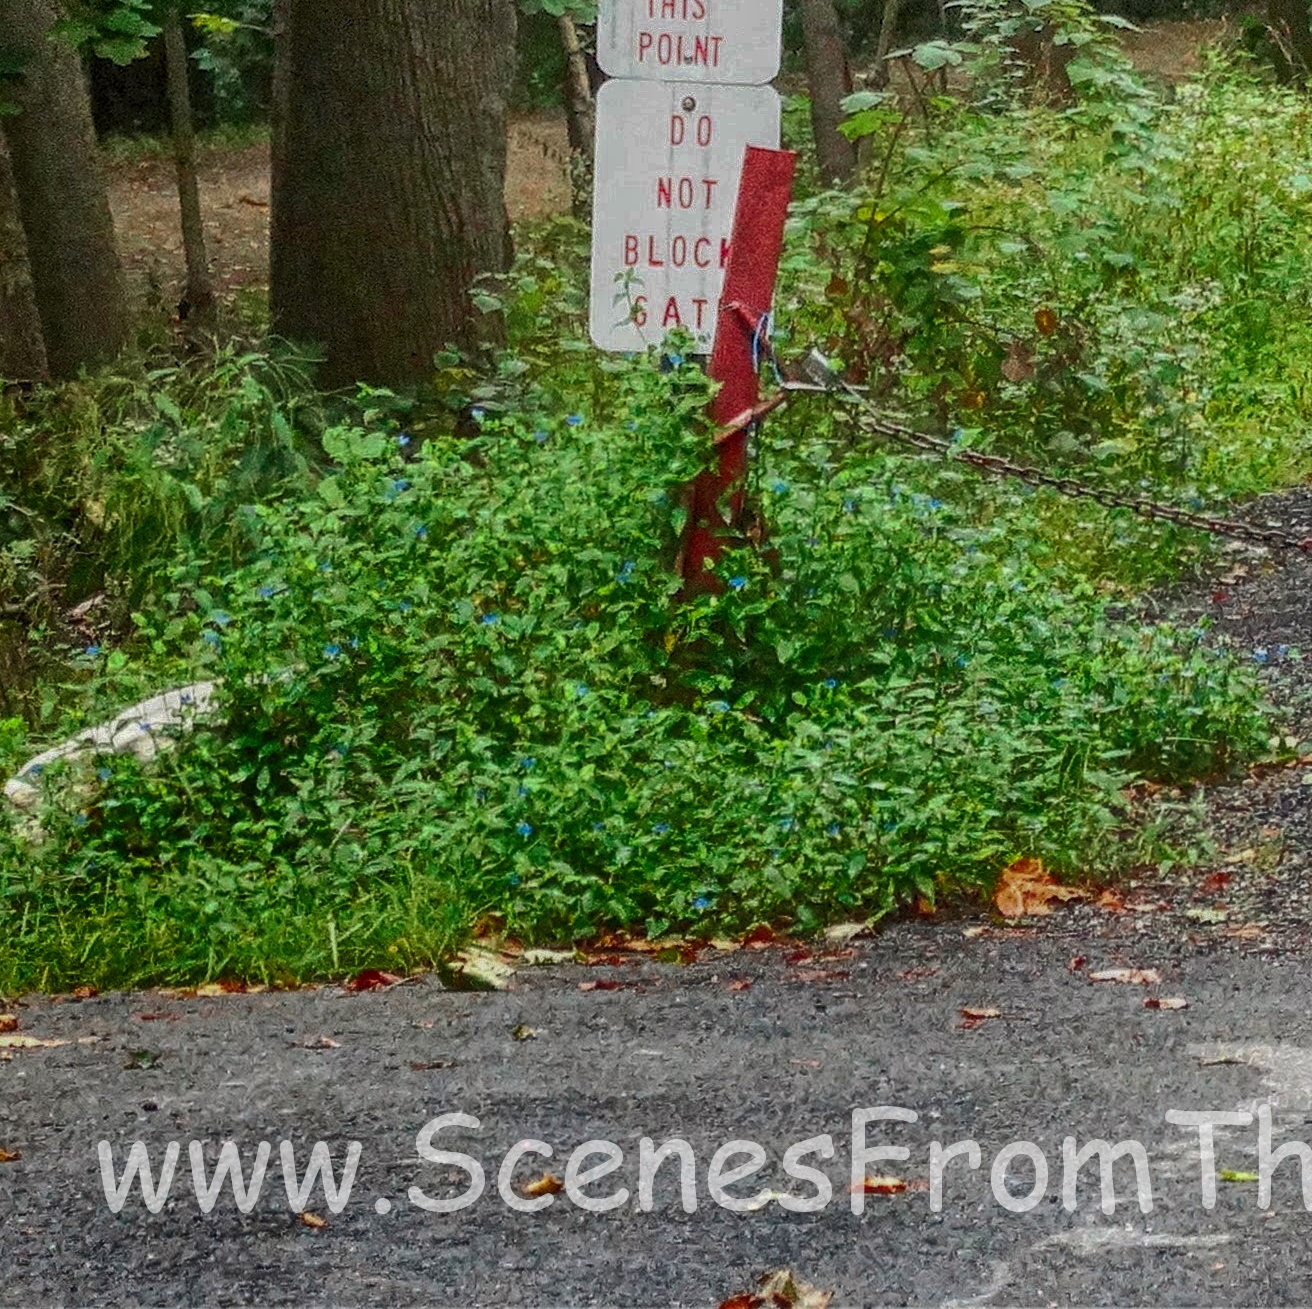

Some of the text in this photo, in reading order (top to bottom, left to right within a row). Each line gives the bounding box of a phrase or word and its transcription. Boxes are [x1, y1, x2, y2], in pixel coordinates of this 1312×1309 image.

[638, 32, 724, 67] POINT
[670, 115, 712, 147] DO
[656, 177, 718, 209] NOT
[633, 296, 721, 329] GAT
